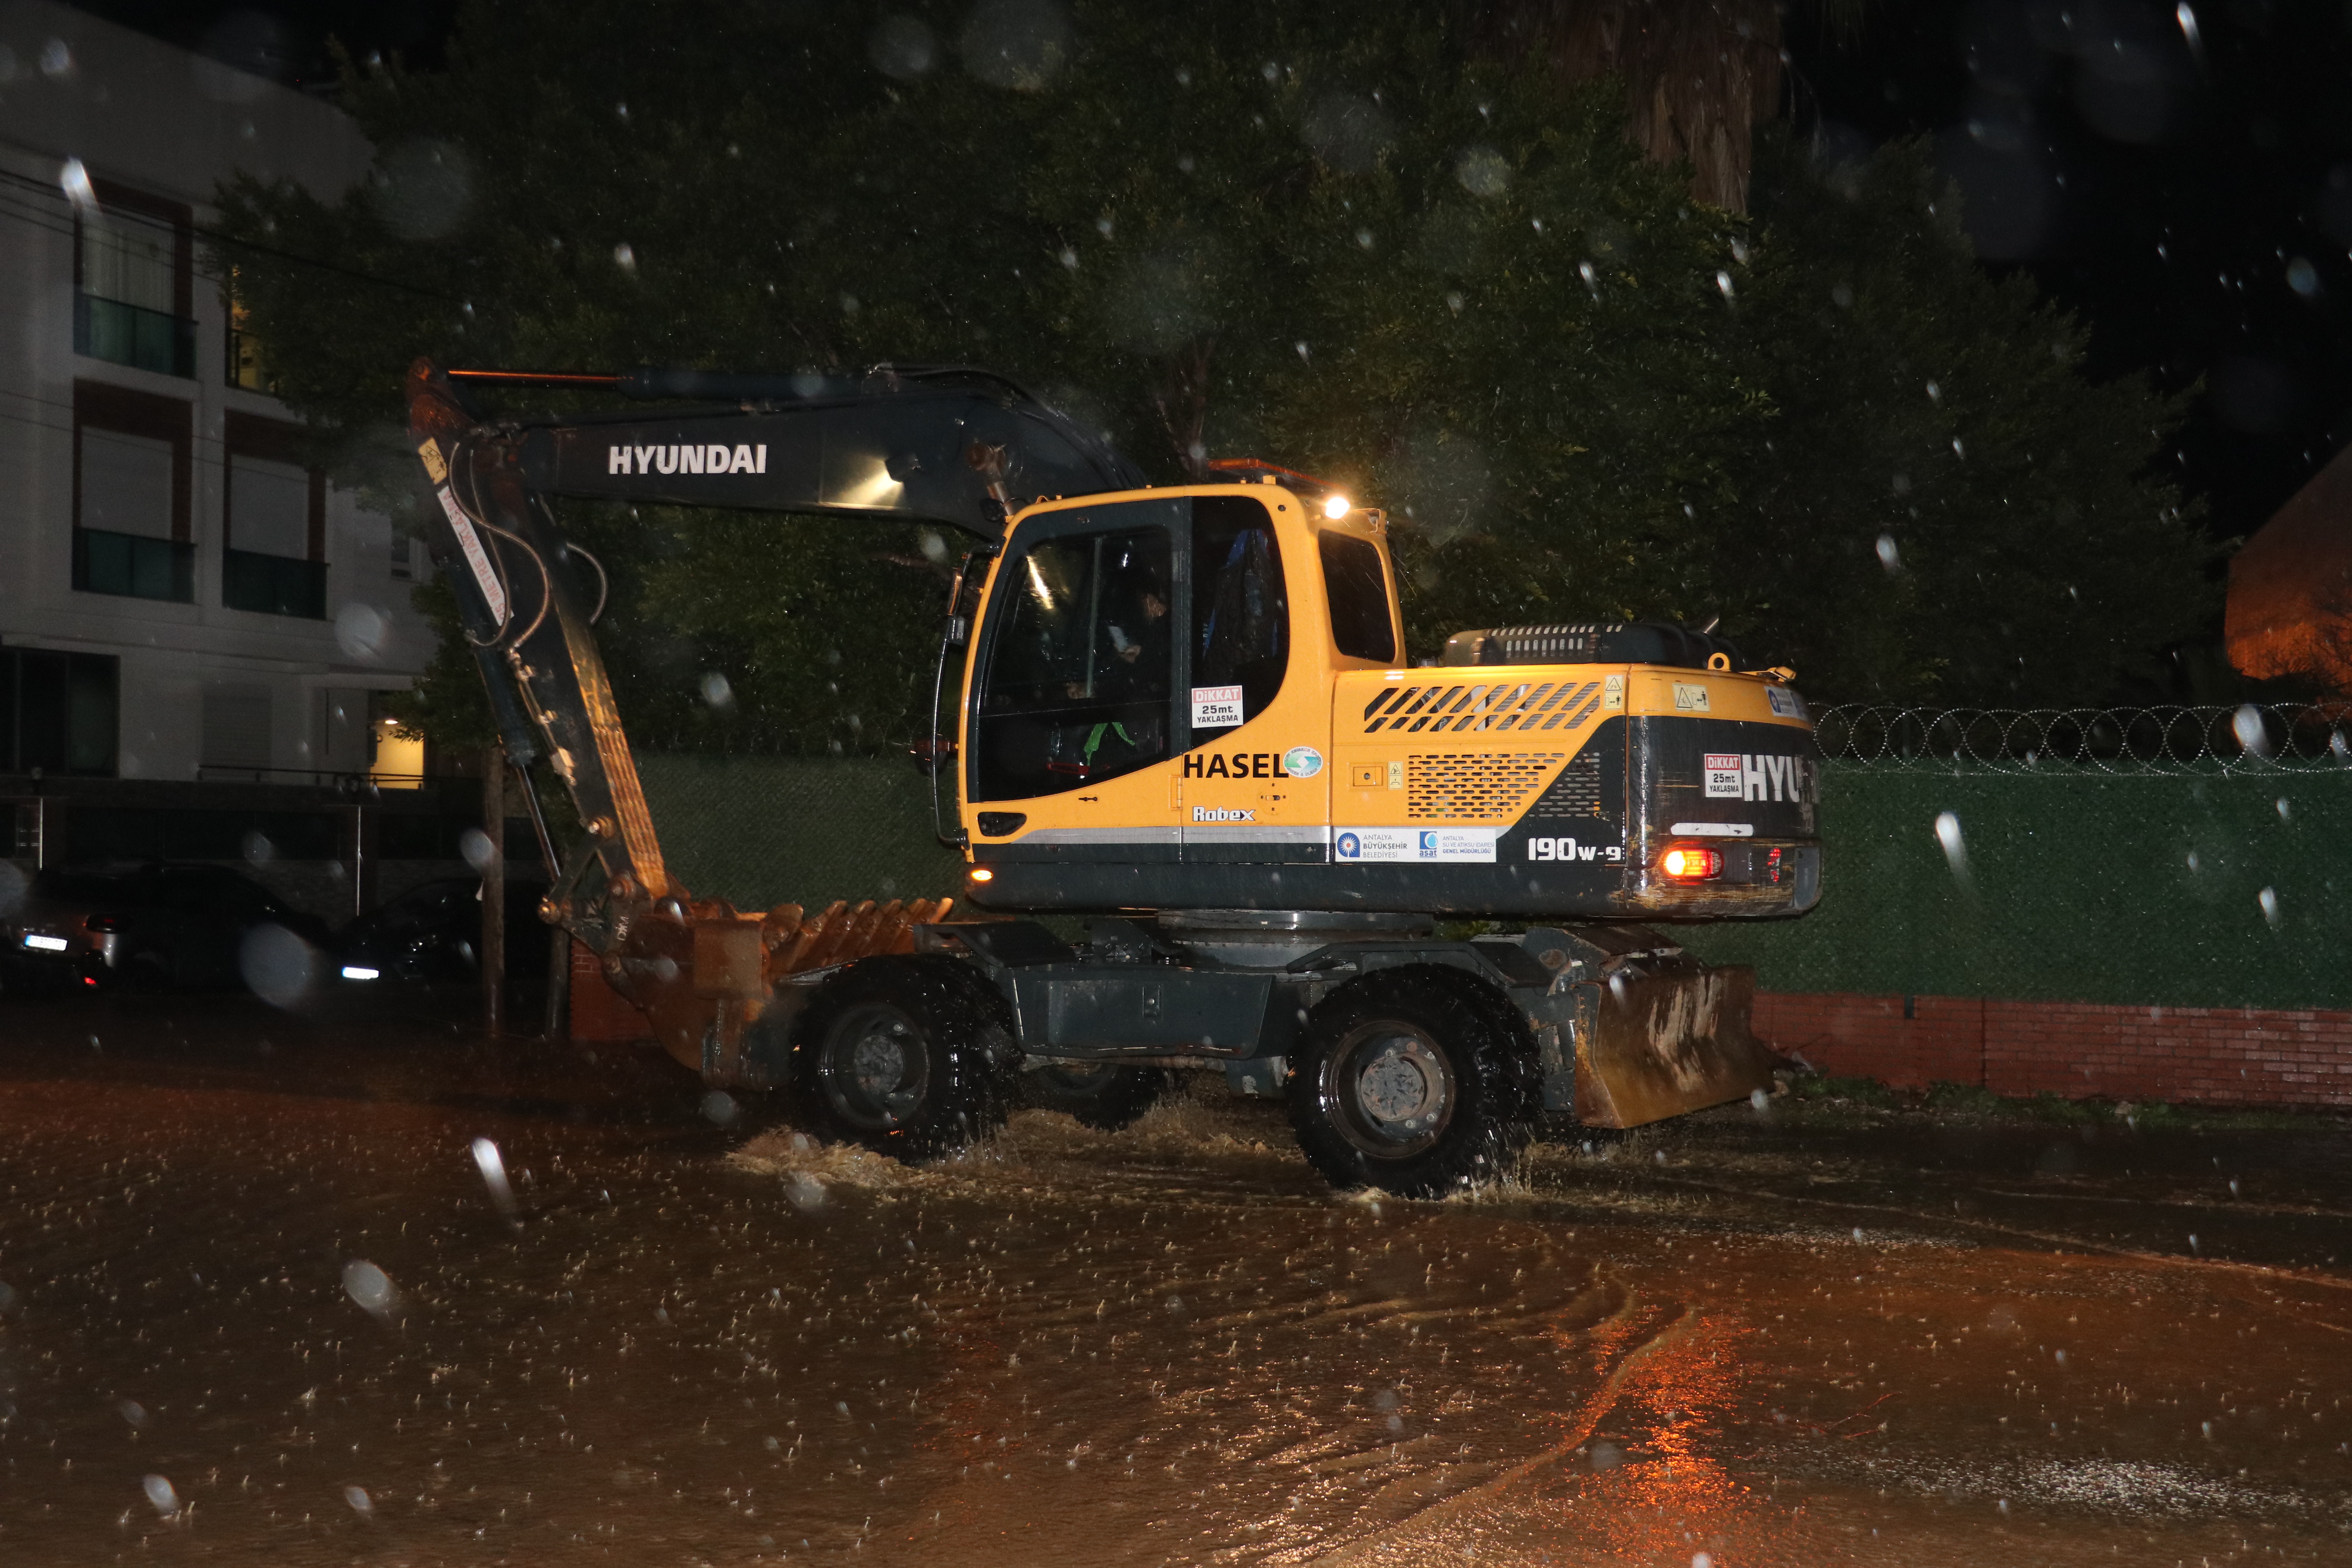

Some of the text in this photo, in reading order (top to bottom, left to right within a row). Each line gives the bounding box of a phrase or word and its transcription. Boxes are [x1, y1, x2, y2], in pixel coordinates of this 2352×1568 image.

[609, 444, 767, 474] HYUNDAI
[474, 557, 501, 603] METRE
[1197, 715, 1238, 724] YAKLAŞMA
[1184, 754, 1289, 778] HASEL
[1710, 785, 1739, 794] YAKLAŞMA
[1192, 806, 1256, 821] Robex
[1363, 842, 1408, 851] BÜYÜKŞEHİR
